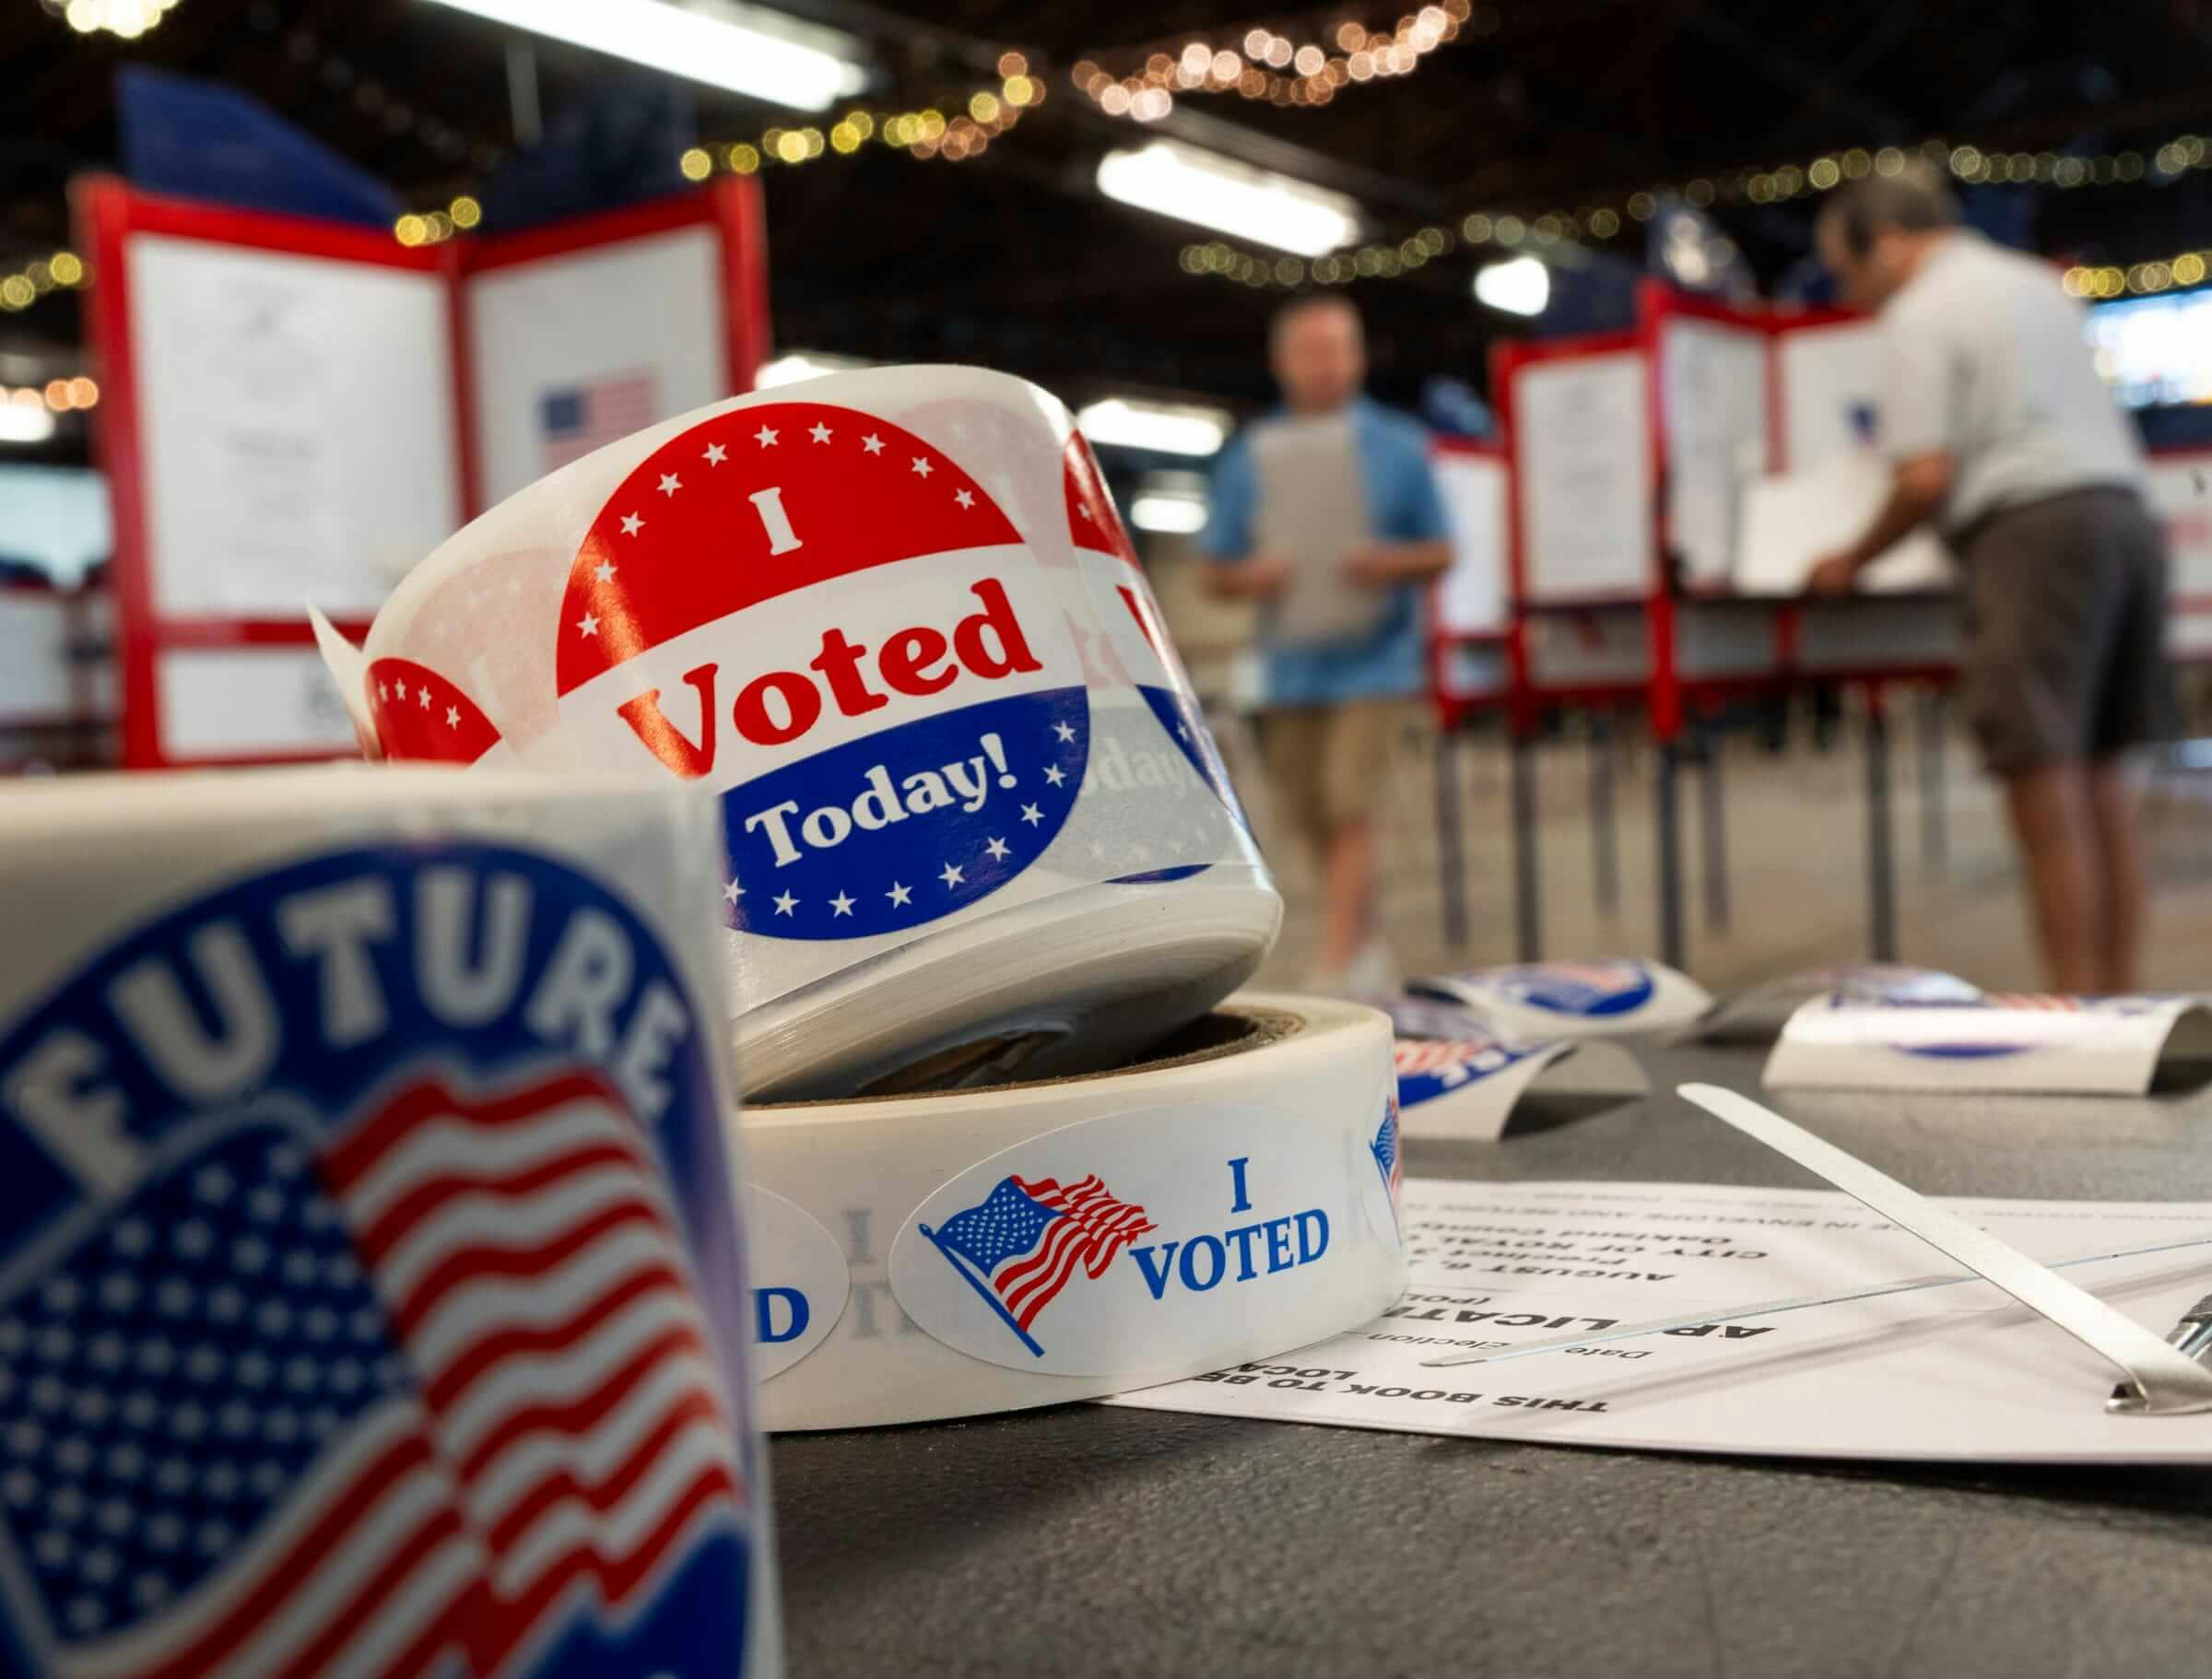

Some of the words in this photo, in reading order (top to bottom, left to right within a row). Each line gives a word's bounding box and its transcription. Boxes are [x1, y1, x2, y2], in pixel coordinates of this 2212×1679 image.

[748, 487, 803, 556] I
[617, 578, 1042, 781] Voted
[746, 733, 1018, 868] Today!
[8, 865, 689, 1198] FUTURE
[1227, 1157, 1252, 1213] I
[1443, 1237, 1576, 1250] ROYAL
[1558, 1229, 1734, 1245] Oakland
[1129, 1209, 1330, 1299] VOTED
[1448, 1249, 1629, 1265] Precinct
[1584, 1244, 1646, 1254] OF
[1657, 1248, 1769, 1260] CITY
[1477, 1263, 1677, 1281] AUGUST
[1380, 1306, 1778, 1338] APLICATI
[1367, 1333, 1513, 1349] Election
[1564, 1346, 1653, 1359] Date
[1194, 1371, 1261, 1385] BE
[1267, 1379, 1328, 1391] TO
[1335, 1383, 1483, 1403] BOOK
[1493, 1396, 1607, 1412] THIS
